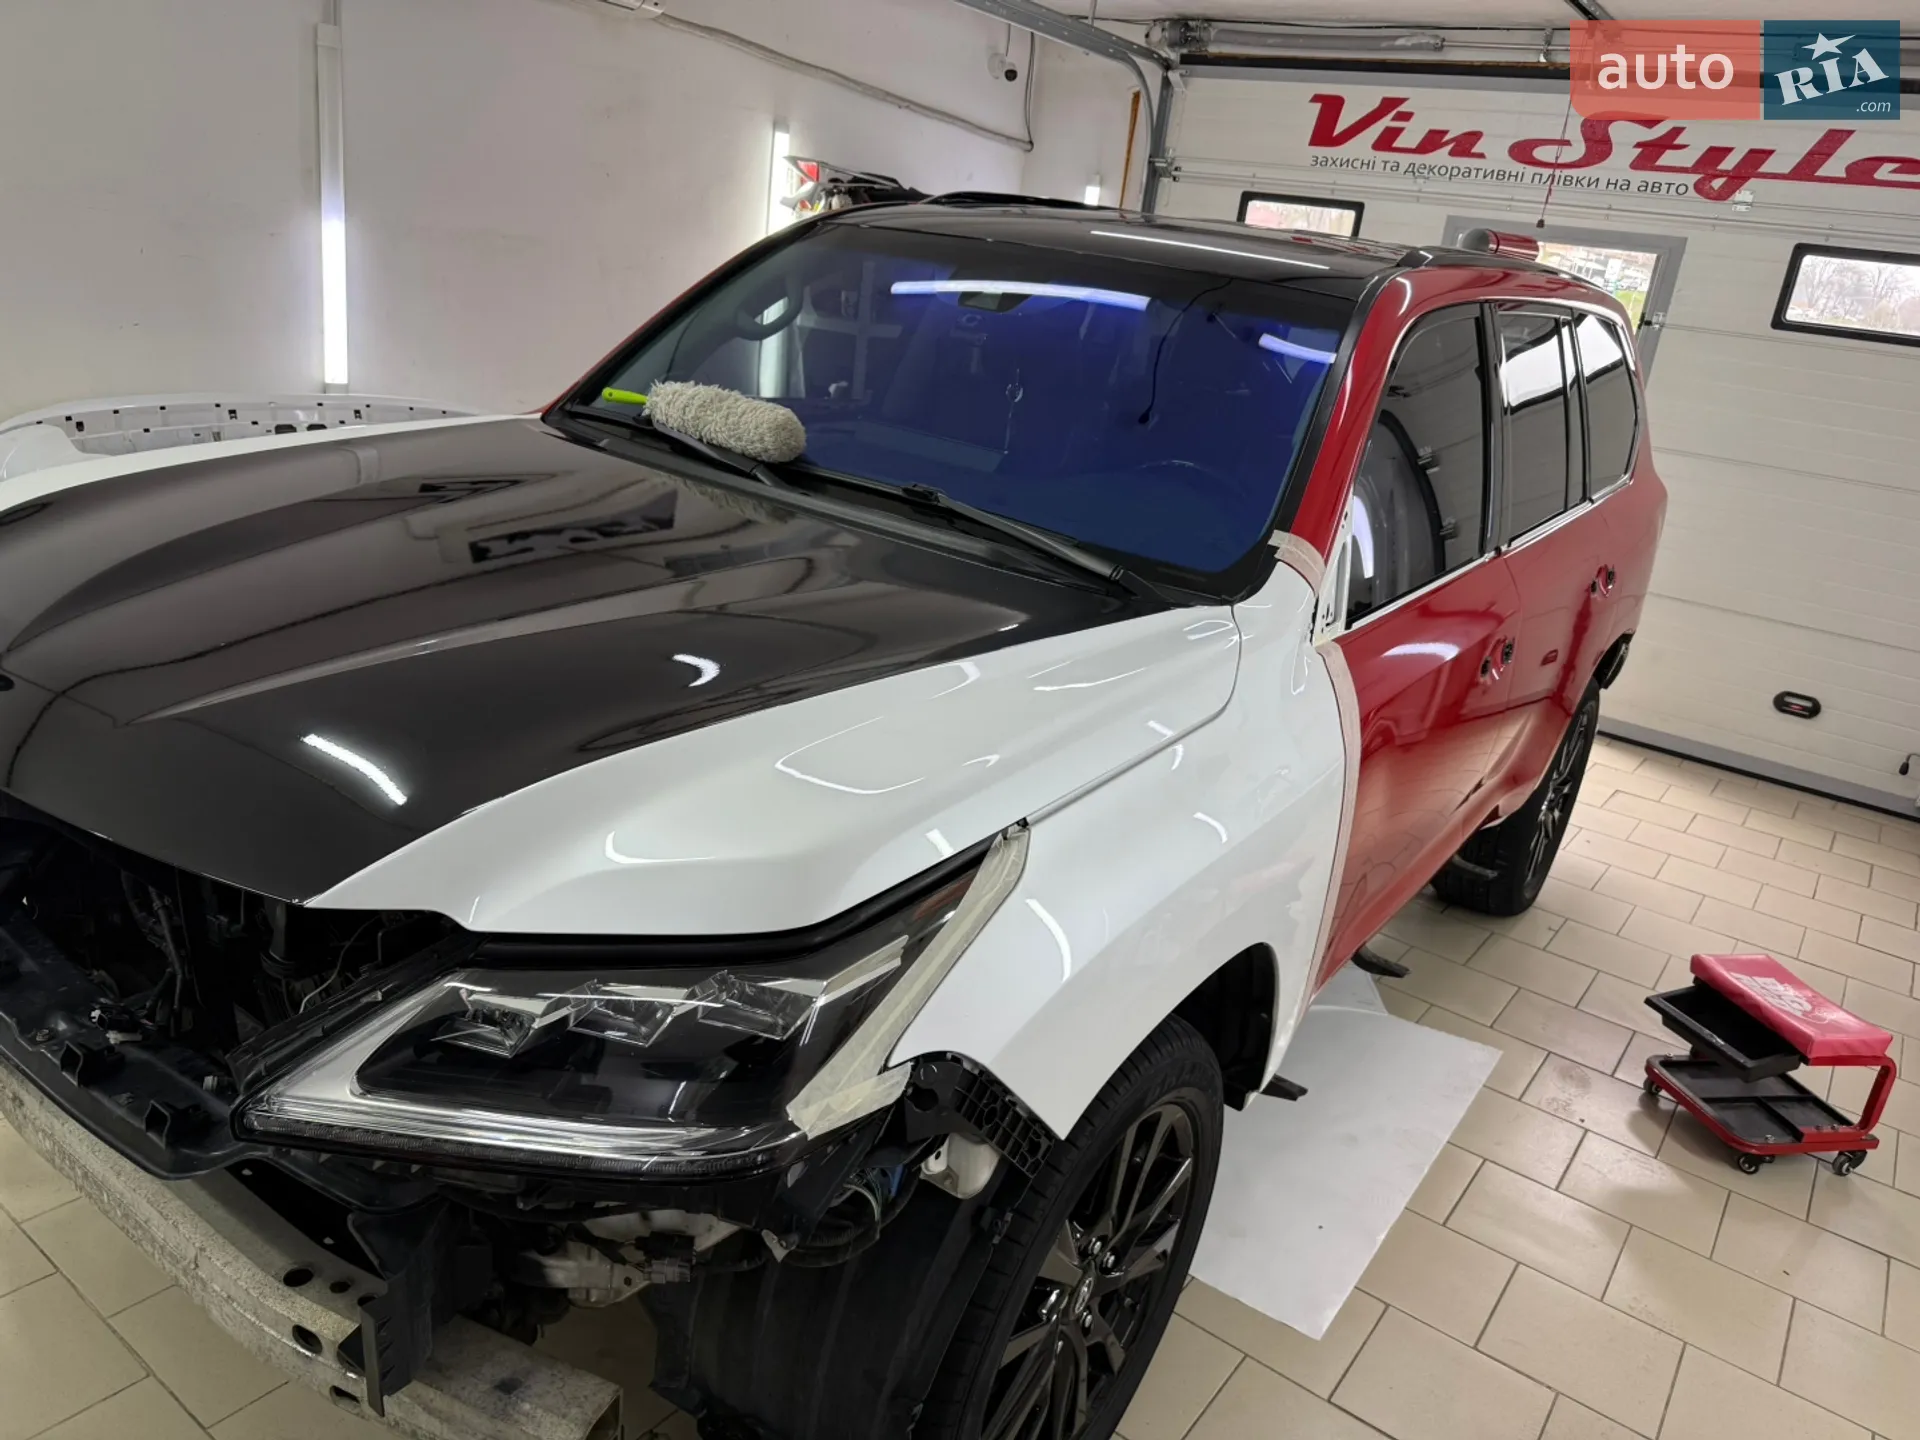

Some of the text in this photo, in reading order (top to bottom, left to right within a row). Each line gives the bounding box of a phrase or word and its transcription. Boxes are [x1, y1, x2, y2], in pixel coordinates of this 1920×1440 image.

[1308, 93, 1486, 159] Vin
[1309, 154, 1689, 196] захисні та декоративні плівки на авто
